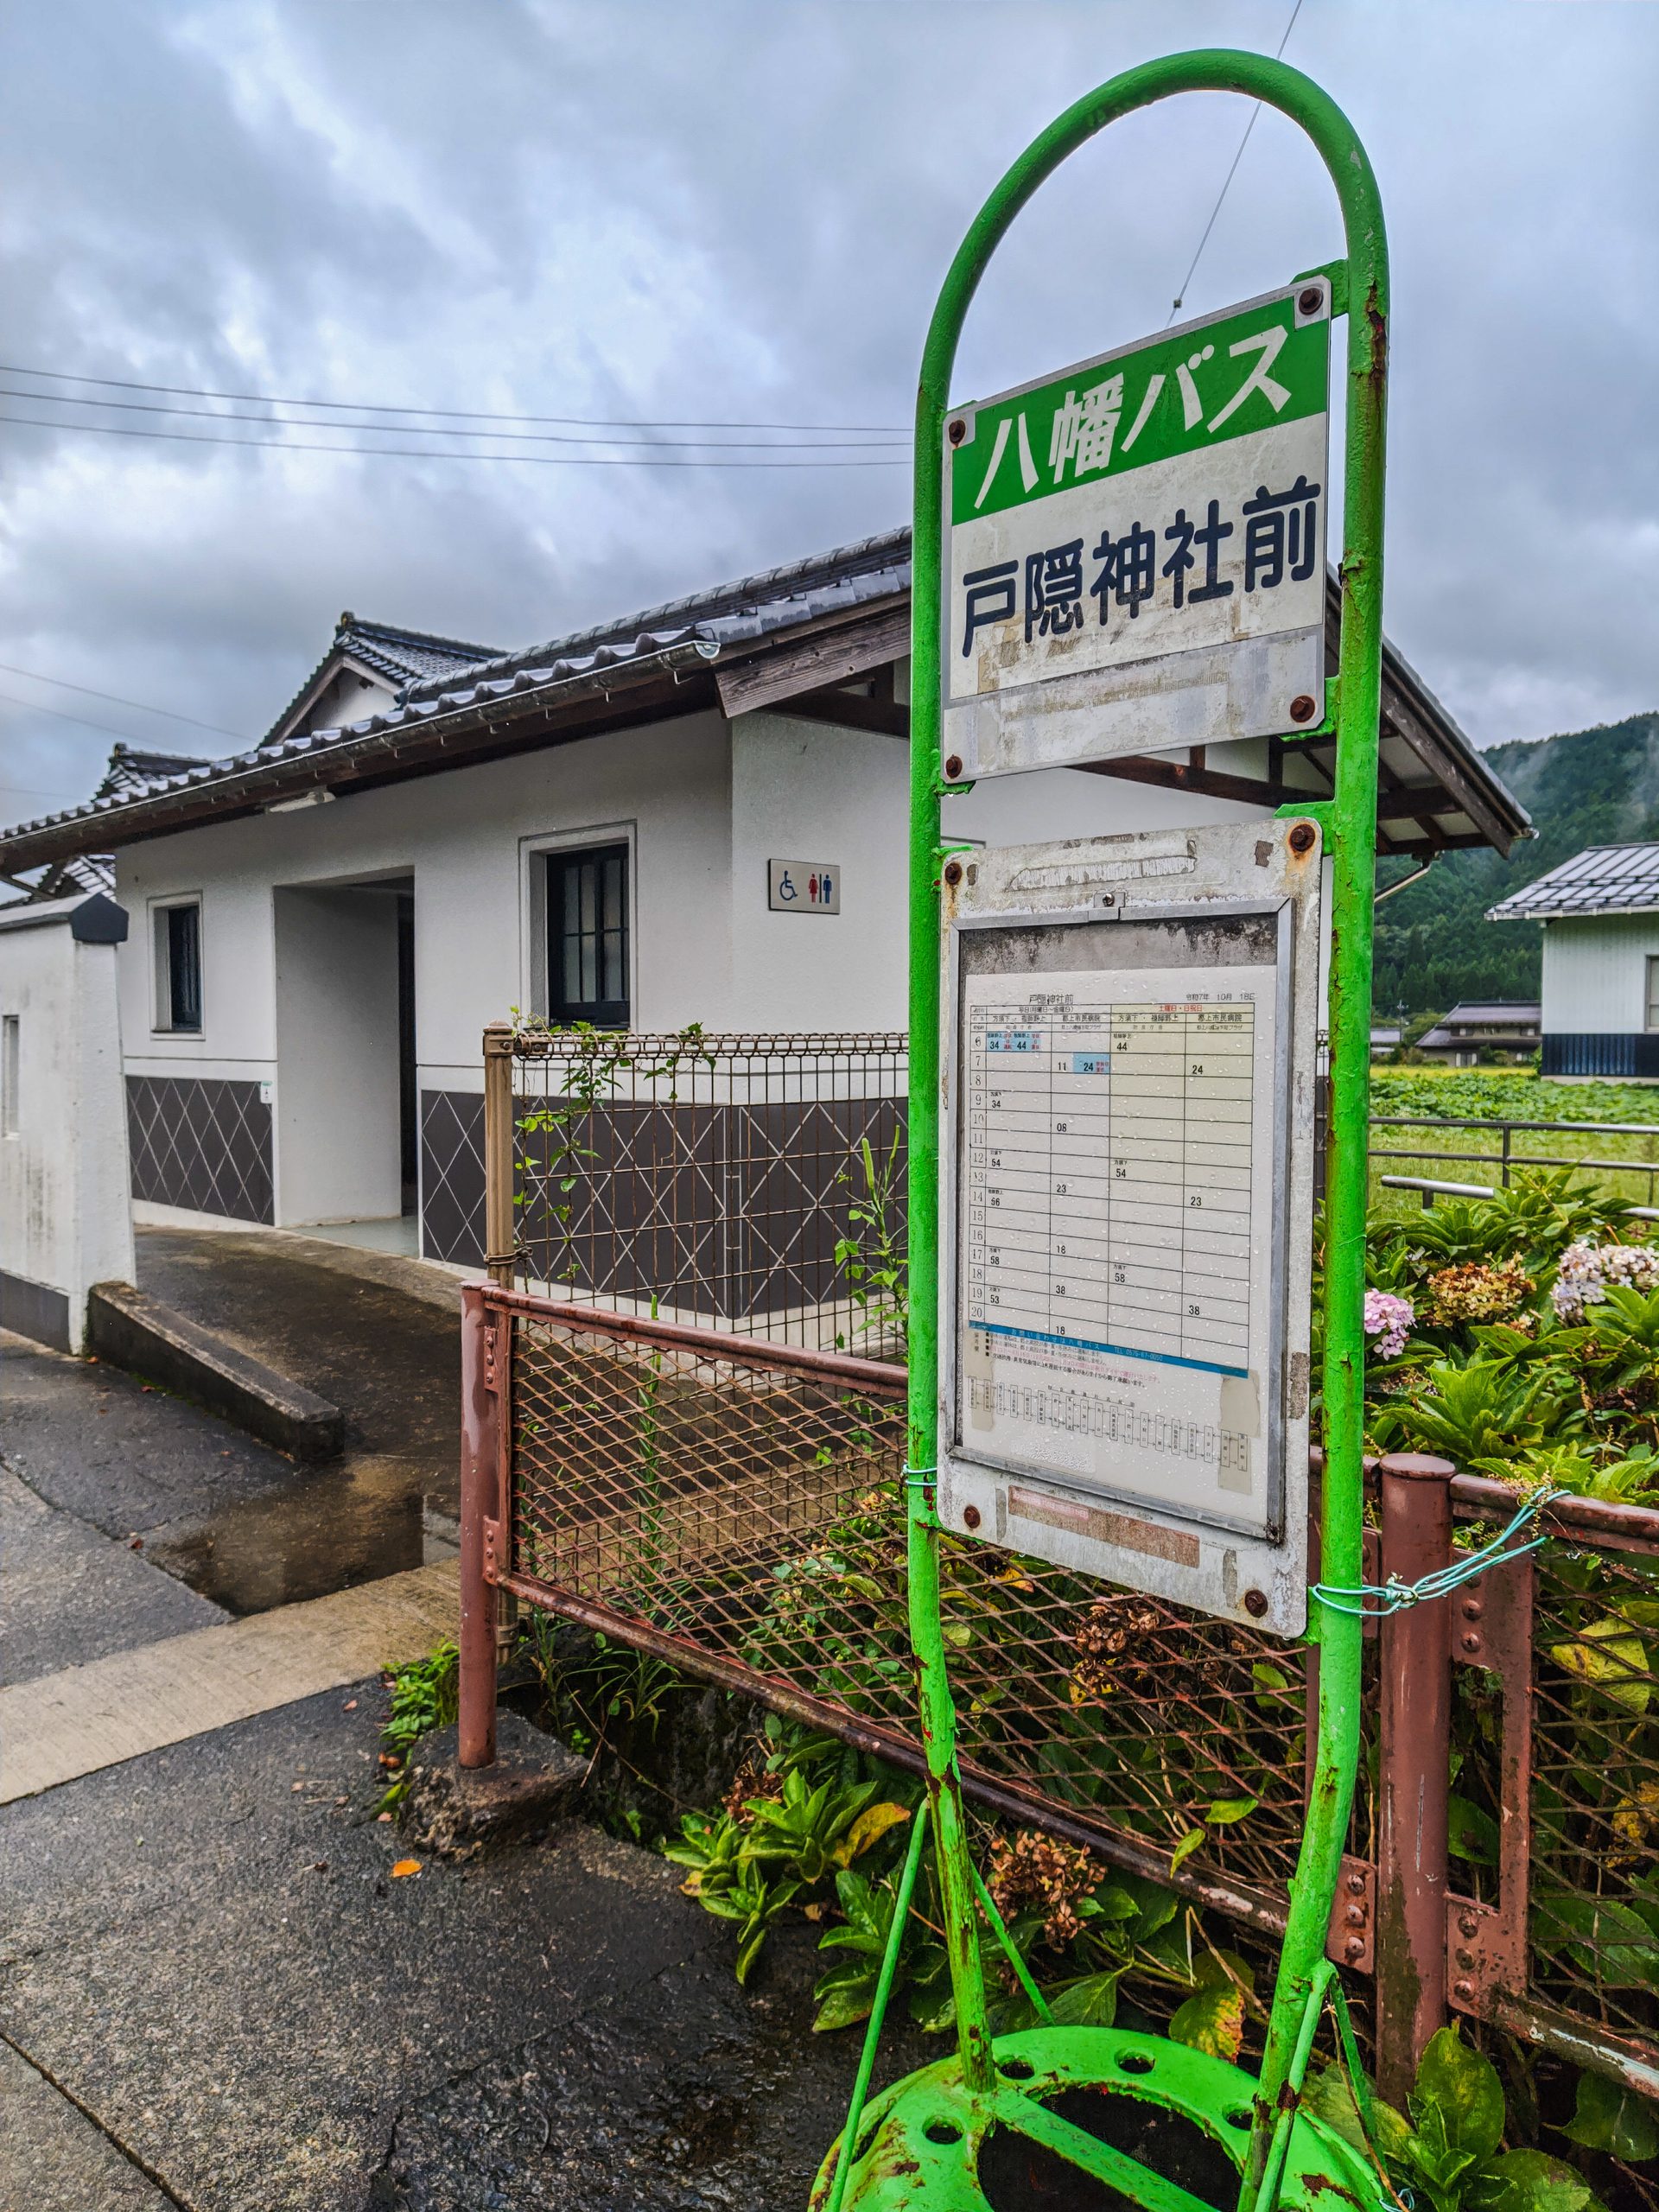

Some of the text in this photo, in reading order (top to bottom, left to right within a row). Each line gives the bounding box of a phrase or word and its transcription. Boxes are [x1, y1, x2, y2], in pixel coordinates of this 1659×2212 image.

[974, 324, 1292, 510] 八幡バス
[962, 474, 1321, 657] 戸隠神社前
[1029, 994, 1074, 1004] 戸隠神社前
[989, 1041, 1000, 1050] 34
[1016, 1041, 1027, 1050] 44
[1116, 1042, 1128, 1051] 44
[976, 1056, 981, 1066] 7
[1058, 1062, 1067, 1071] 11
[1084, 1063, 1094, 1071] 24
[1192, 1065, 1204, 1074] 24
[976, 1075, 982, 1085] 8
[976, 1094, 982, 1105] 9
[991, 1100, 1001, 1109] 34
[974, 1114, 984, 1124] 10
[1056, 1123, 1067, 1132] 08
[974, 1134, 983, 1143] 11
[973, 1153, 983, 1163] 12
[974, 1172, 983, 1183] 13
[1116, 1168, 1126, 1178] 54
[1056, 1184, 1066, 1193] 23
[973, 1191, 982, 1202] 14
[1191, 1196, 1202, 1206] 23
[973, 1211, 983, 1221] 15
[973, 1230, 983, 1241] 16
[972, 1249, 982, 1260] 17
[1056, 1245, 1066, 1254] 18
[990, 1255, 1000, 1265] 58
[972, 1268, 982, 1279] 18
[1115, 1273, 1125, 1282] 58
[972, 1287, 982, 1298] 19
[1056, 1285, 1065, 1294] 38
[990, 1294, 1000, 1304] 53
[971, 1306, 982, 1318] 20
[1188, 1305, 1200, 1315] 38
[1056, 1325, 1065, 1335] 18
